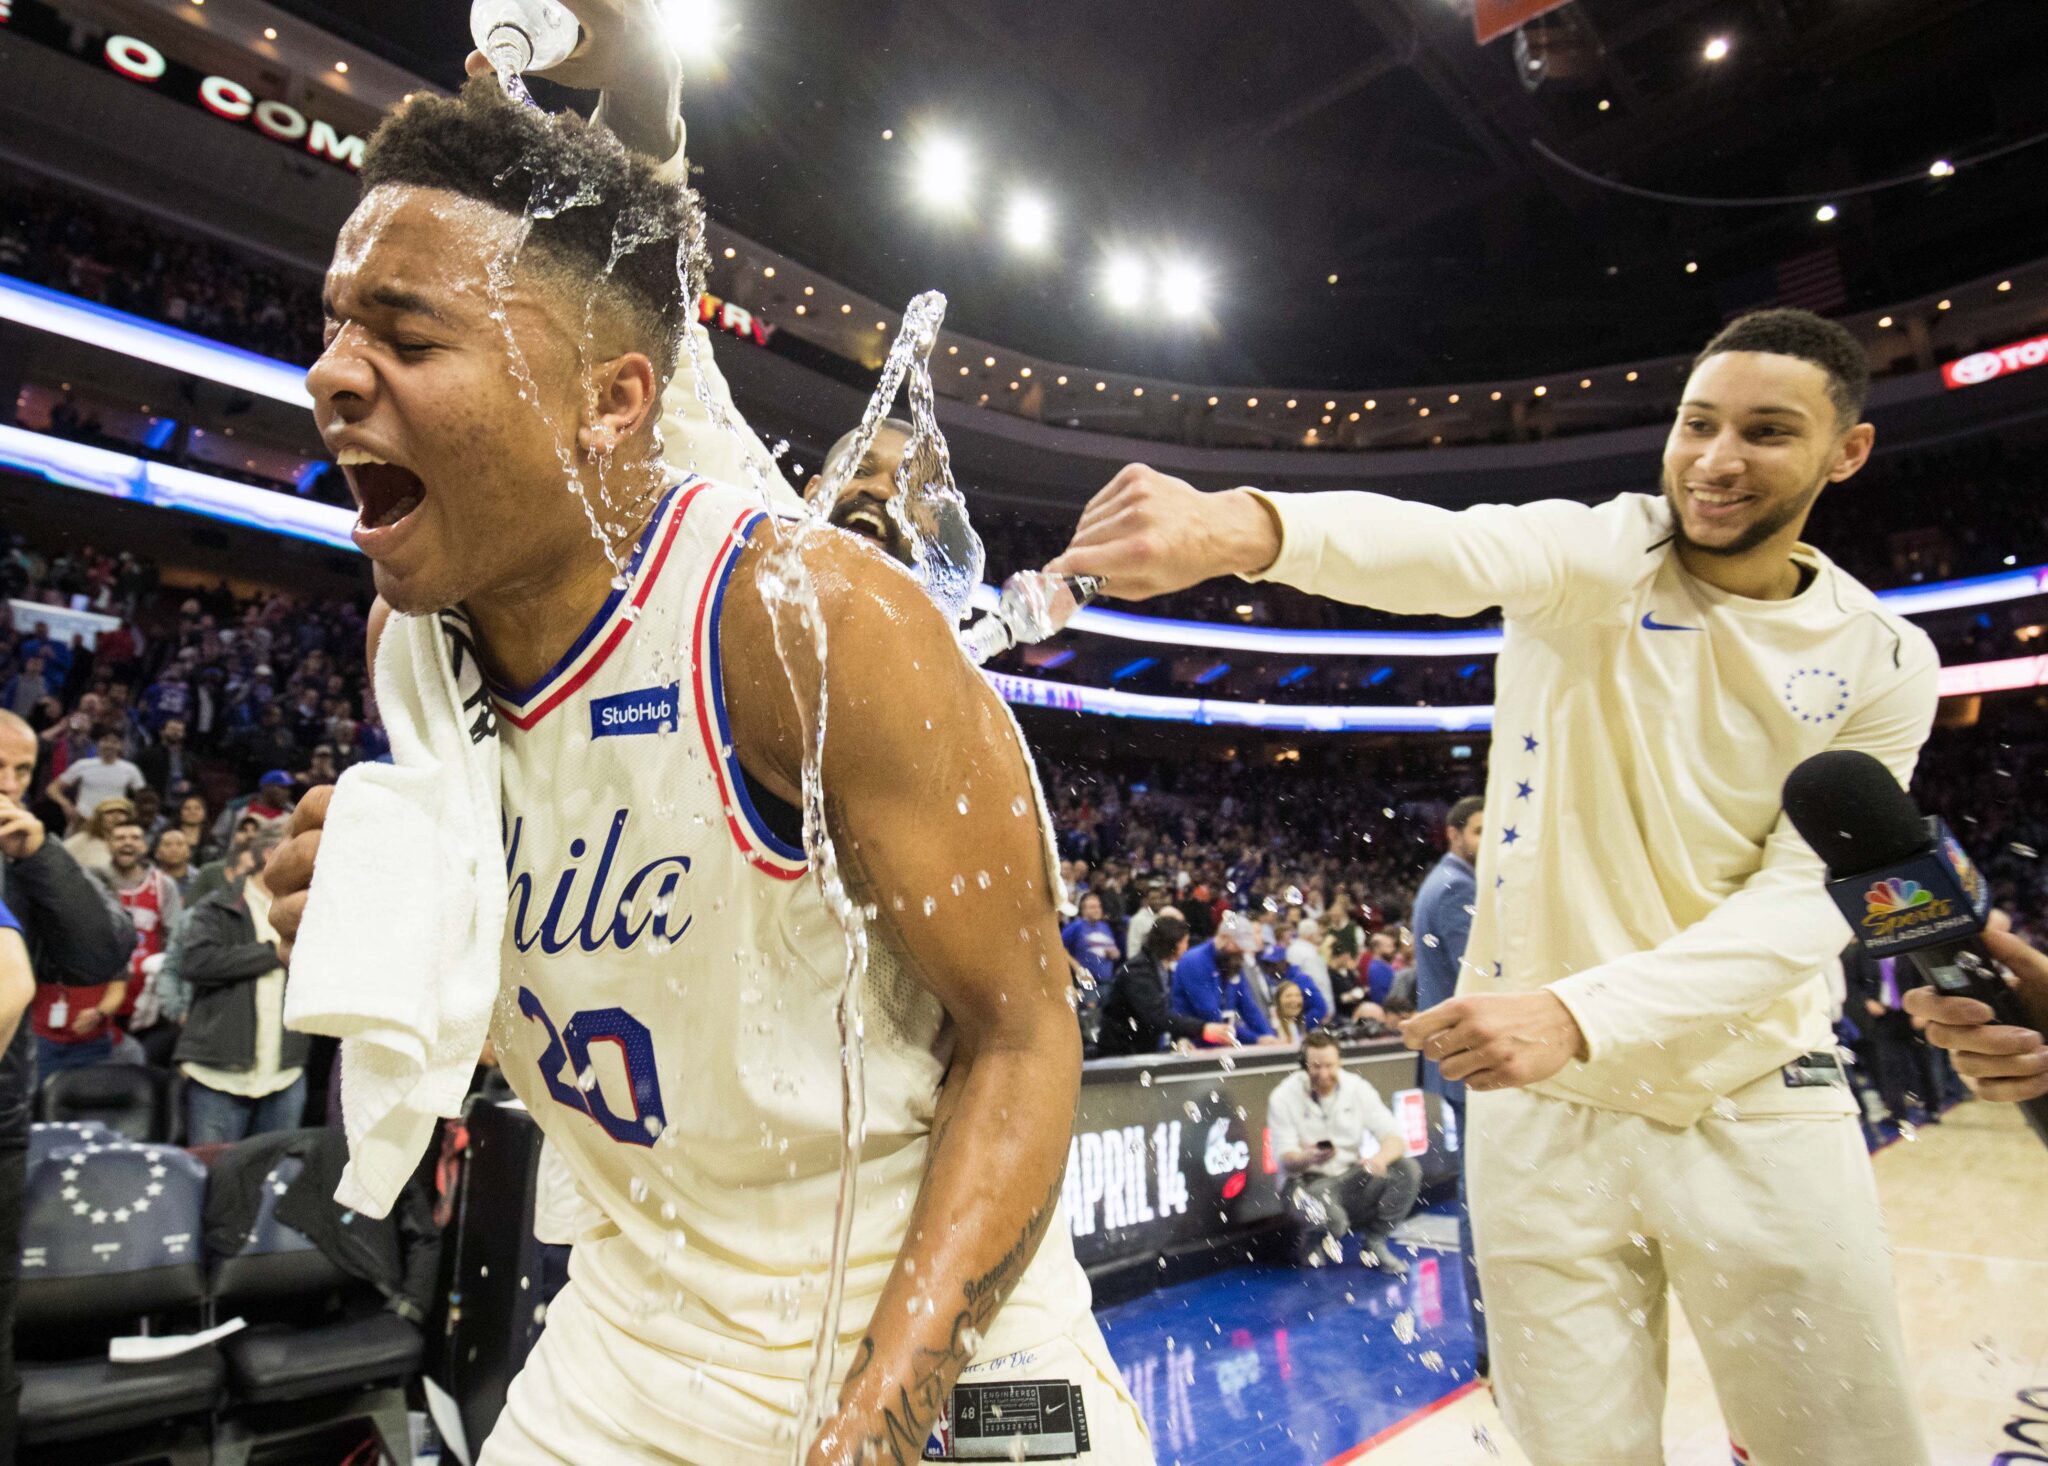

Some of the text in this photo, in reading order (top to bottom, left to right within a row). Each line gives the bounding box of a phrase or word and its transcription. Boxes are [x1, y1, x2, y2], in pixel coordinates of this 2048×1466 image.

[1999, 338, 2048, 370] TO
[602, 700, 671, 726] StubHub
[500, 808, 692, 954] hila
[1861, 899, 1952, 936] Sports
[1865, 915, 1973, 948] PHILADELPHIA
[518, 985, 667, 1149] 20
[1061, 1129, 1154, 1236] APRIL
[1153, 1120, 1189, 1217] 14
[983, 1389, 1037, 1399] ENGINEERED
[961, 1406, 975, 1420] 48
